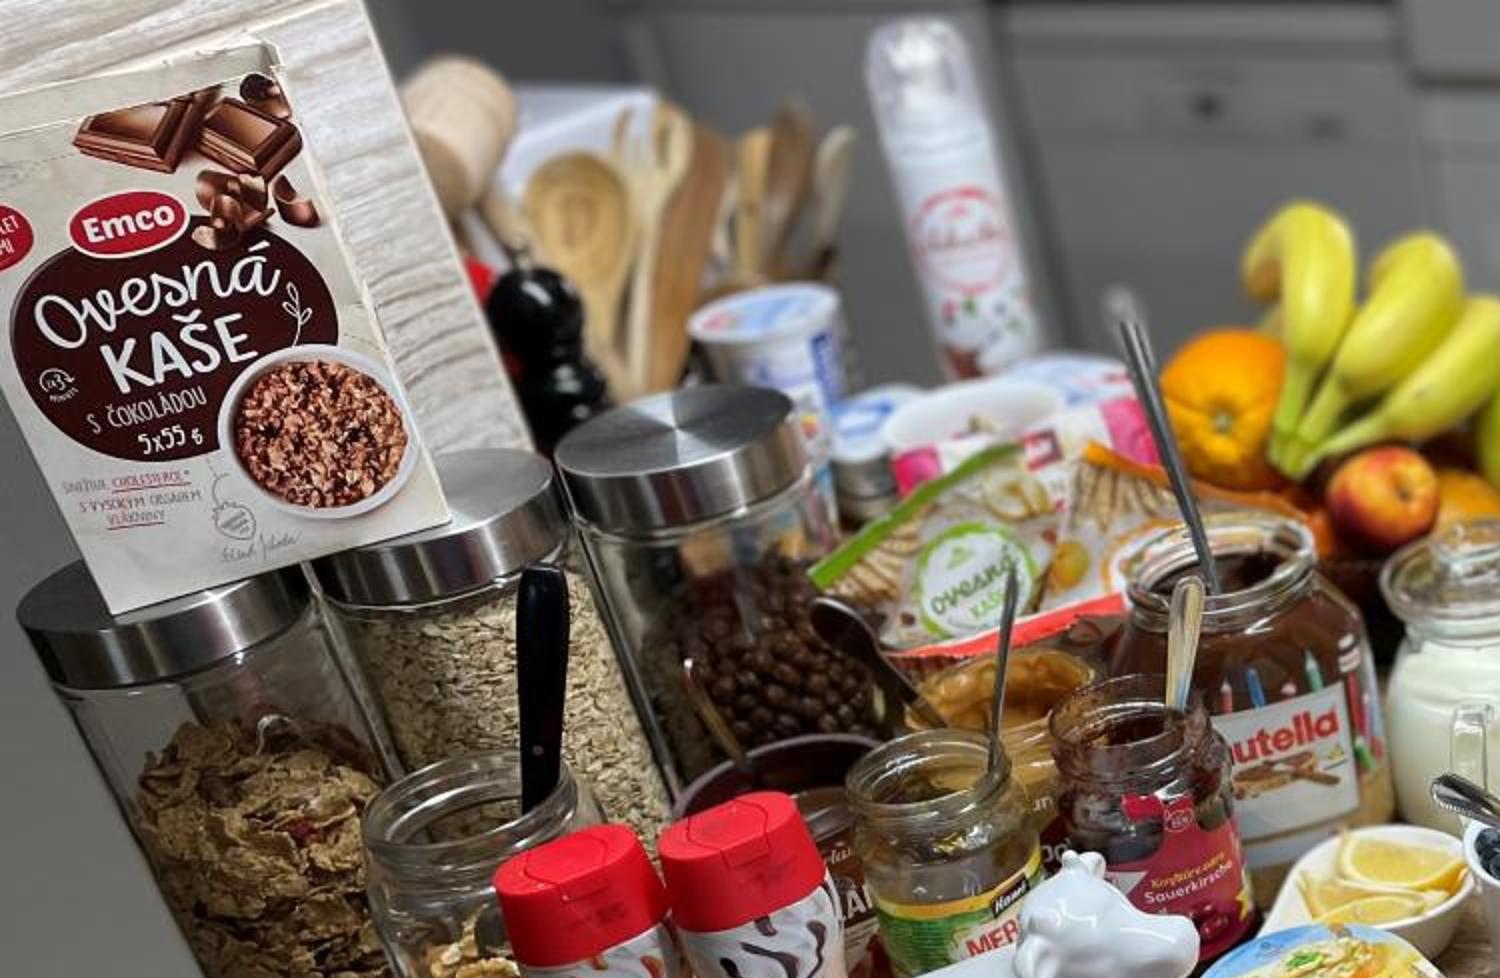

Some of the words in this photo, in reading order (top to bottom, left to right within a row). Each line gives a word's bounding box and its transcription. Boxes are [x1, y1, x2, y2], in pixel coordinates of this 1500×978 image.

[82, 205, 175, 243] Emco
[34, 240, 281, 348] Ovesná
[100, 309, 258, 394] KAŠE
[105, 385, 208, 428] ČOKOLÁDOU
[137, 425, 186, 455] 5x55
[1231, 708, 1340, 765] utella
